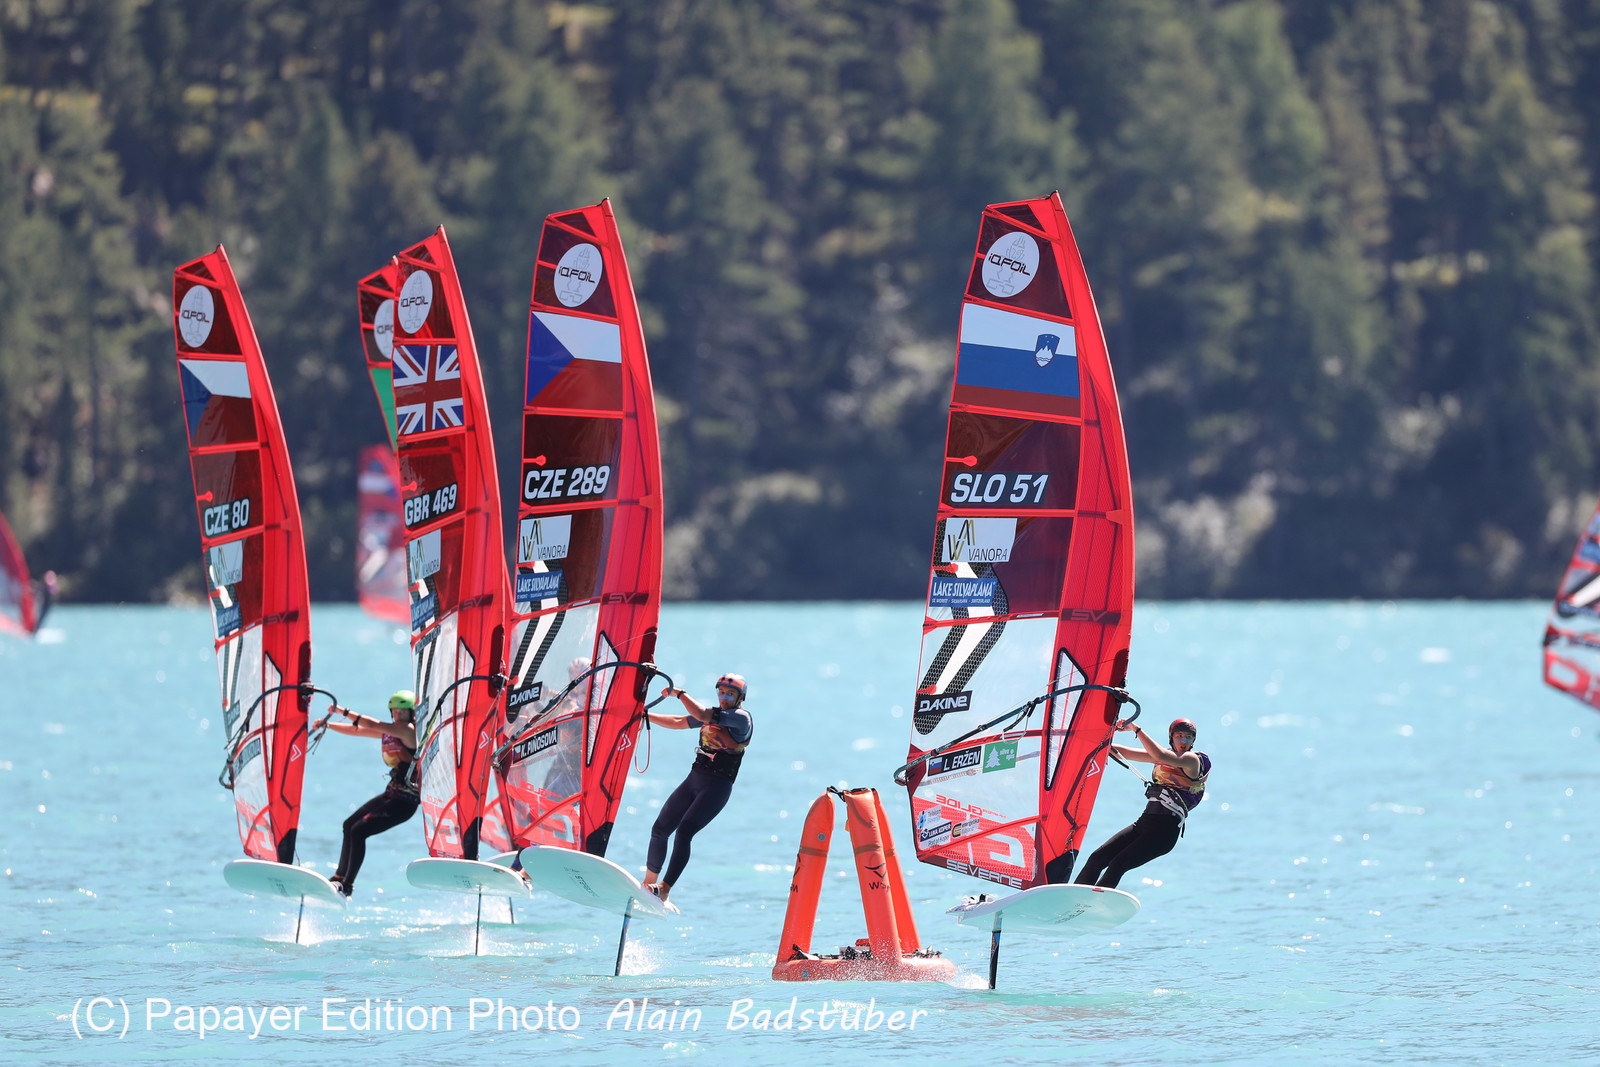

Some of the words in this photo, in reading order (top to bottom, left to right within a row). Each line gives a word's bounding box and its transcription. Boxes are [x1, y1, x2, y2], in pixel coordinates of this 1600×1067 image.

[524, 468, 567, 500] CZE
[567, 465, 611, 496] 289
[950, 473, 1006, 503] SLO
[1009, 474, 1049, 503] 51
[404, 494, 430, 526] GBR
[432, 483, 458, 515] 469
[204, 503, 230, 536] CZE
[232, 498, 250, 529] 80
[537, 545, 566, 560] VANORA
[968, 548, 1010, 562] VANORA
[517, 577, 532, 593] LAKE
[932, 581, 953, 597] LAKE
[952, 581, 993, 598] SILVAPLANA
[918, 695, 969, 713] DAKINE
[951, 750, 981, 769] ERŽEN
[946, 858, 1023, 889] SEVERNE
